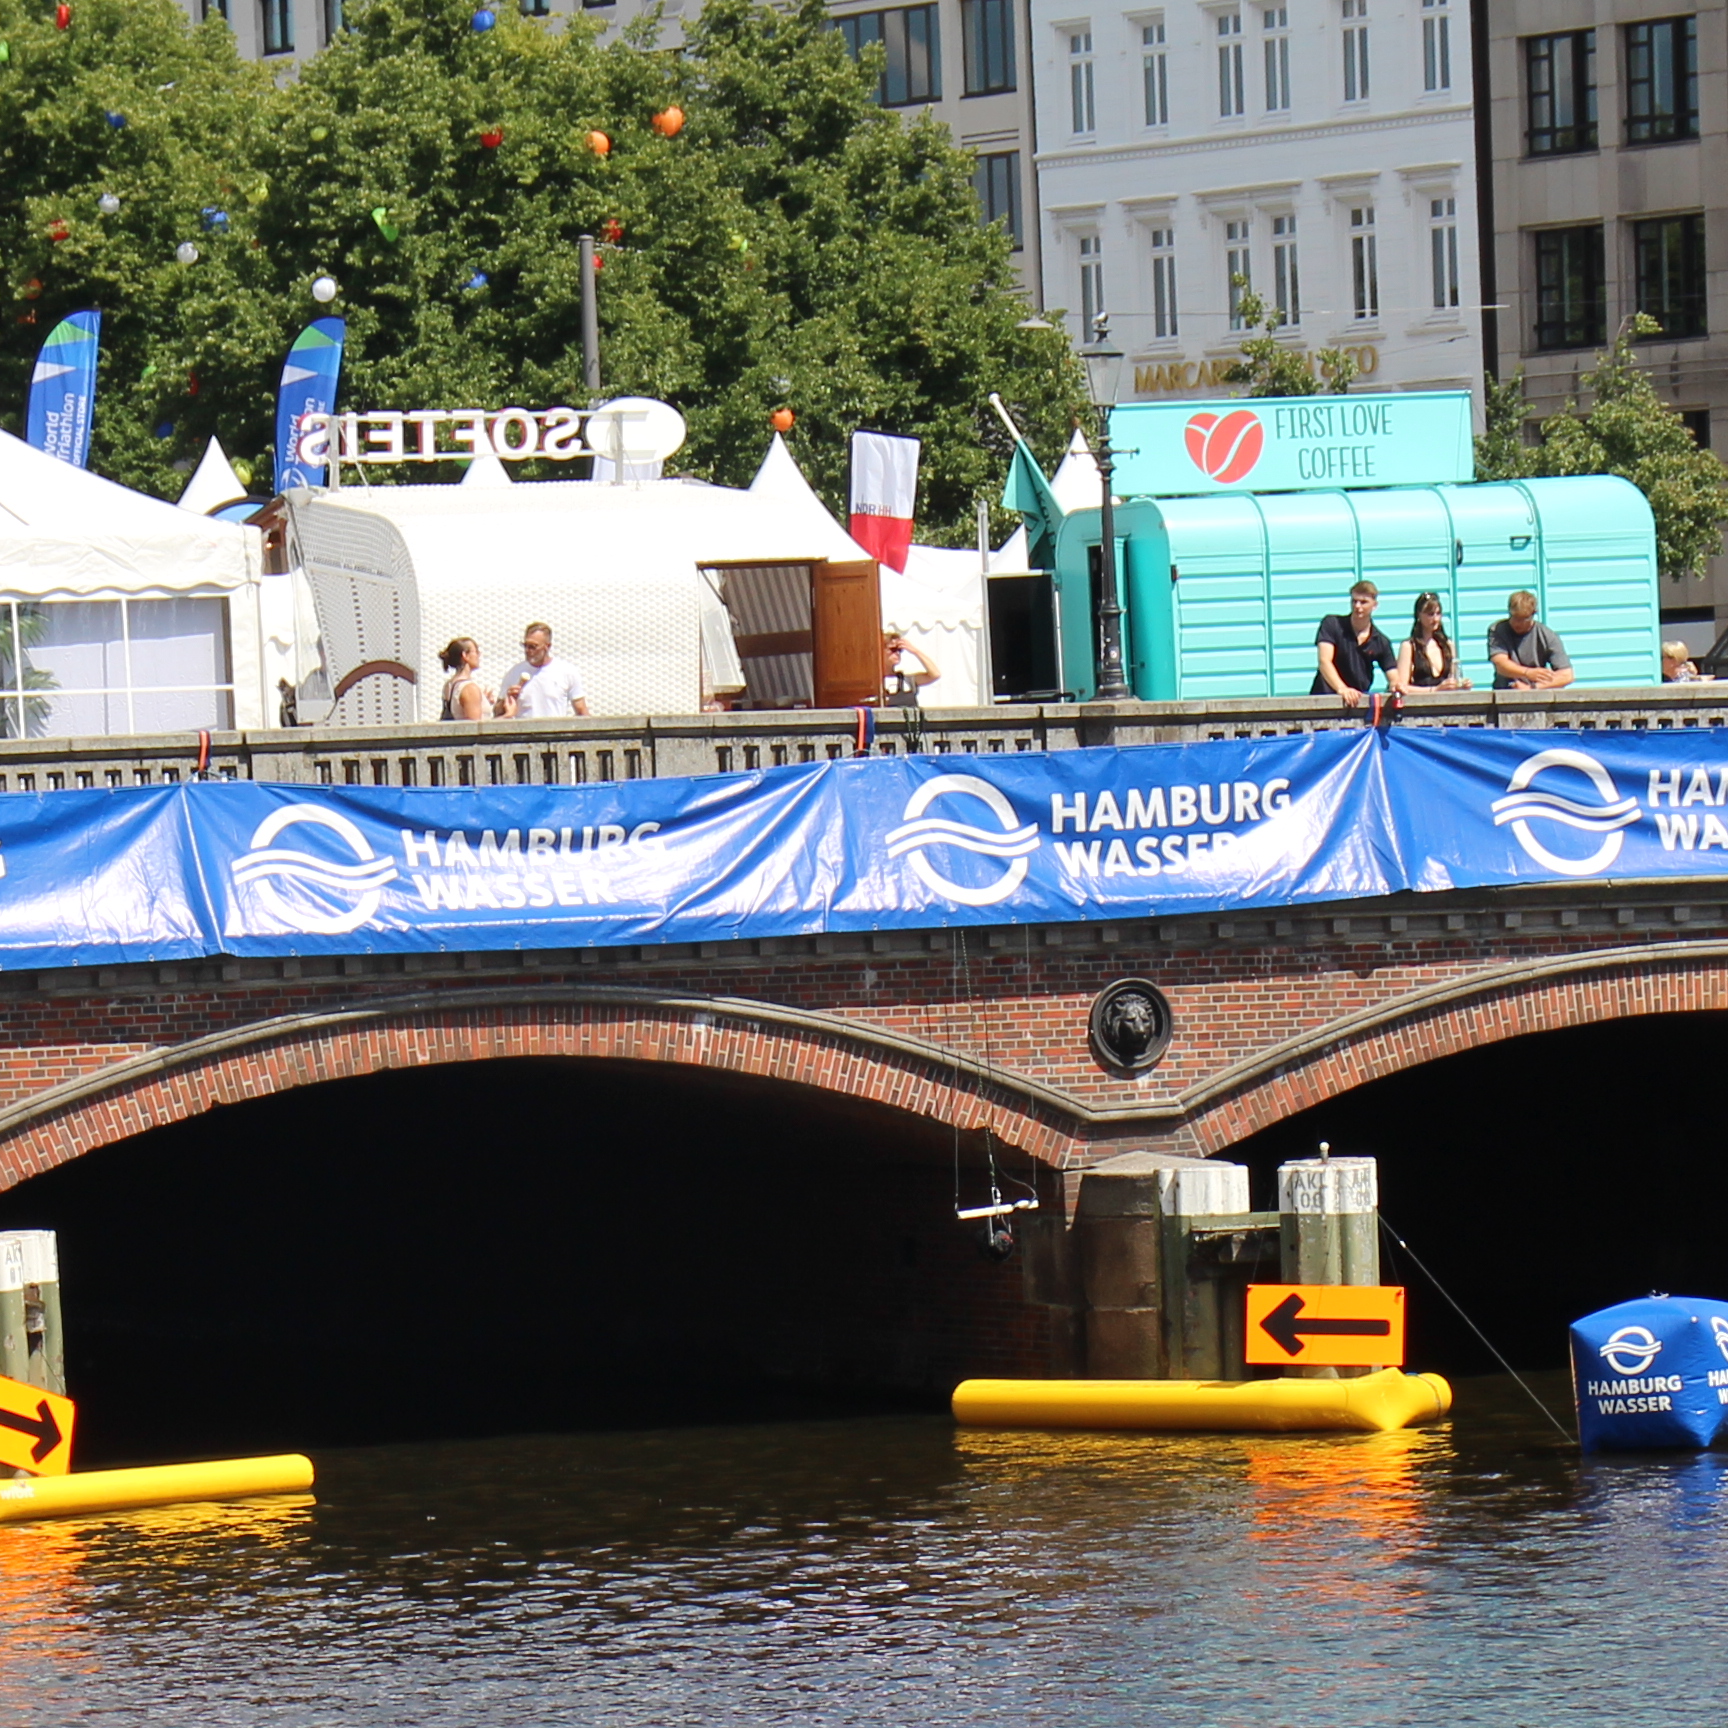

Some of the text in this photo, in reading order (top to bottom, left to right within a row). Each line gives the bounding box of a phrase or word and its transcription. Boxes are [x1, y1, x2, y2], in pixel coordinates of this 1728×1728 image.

[57, 392, 75, 460] Triathlon
[1275, 404, 1394, 440] FIRST LOVE
[1298, 446, 1377, 480] COFFEE
[856, 502, 877, 515] NDR
[1051, 777, 1291, 835] HAMBURG
[400, 821, 669, 869] HAMBURG
[415, 872, 619, 912] WASSER
[1588, 1374, 1683, 1396] HAMBURG
[1598, 1395, 1672, 1415] WASSER
